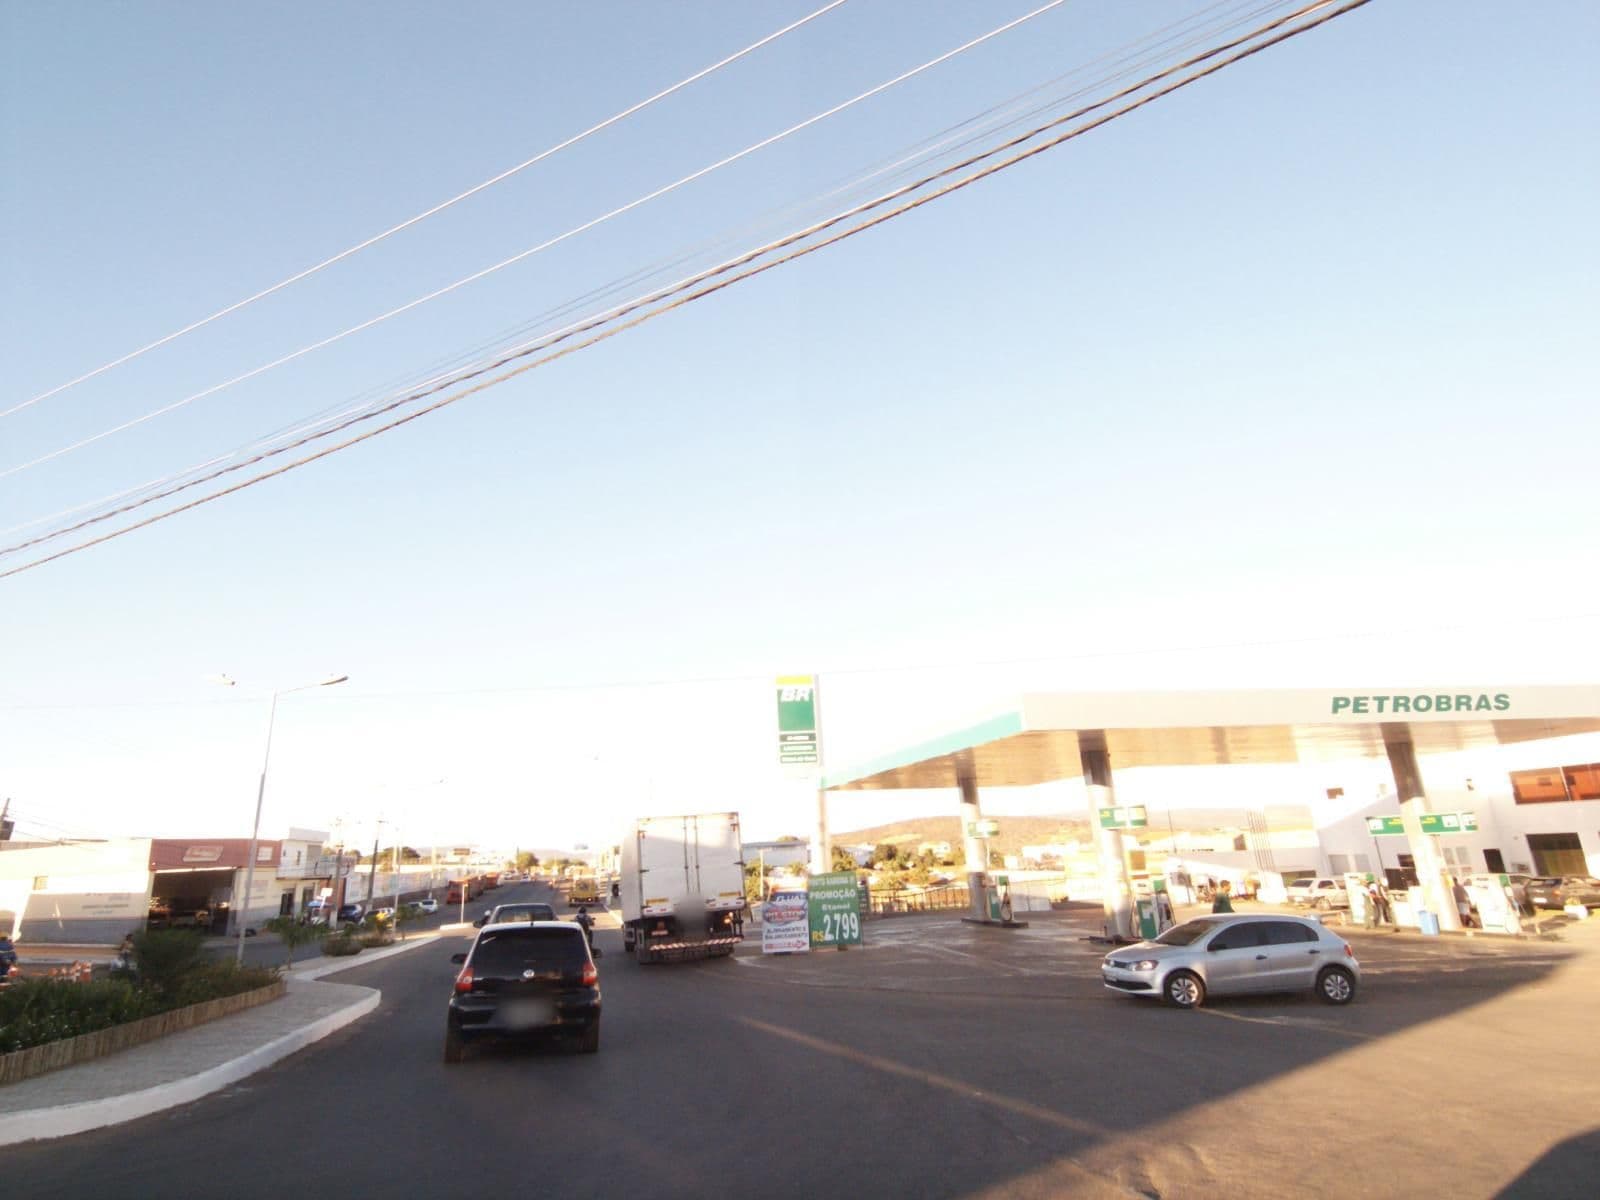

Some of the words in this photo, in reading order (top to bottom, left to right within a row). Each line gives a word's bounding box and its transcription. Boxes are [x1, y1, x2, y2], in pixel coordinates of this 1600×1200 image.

[780, 688, 810, 702] BR
[1331, 693, 1511, 715] PETROBRAS
[809, 888, 856, 900] PROMOÇÃO
